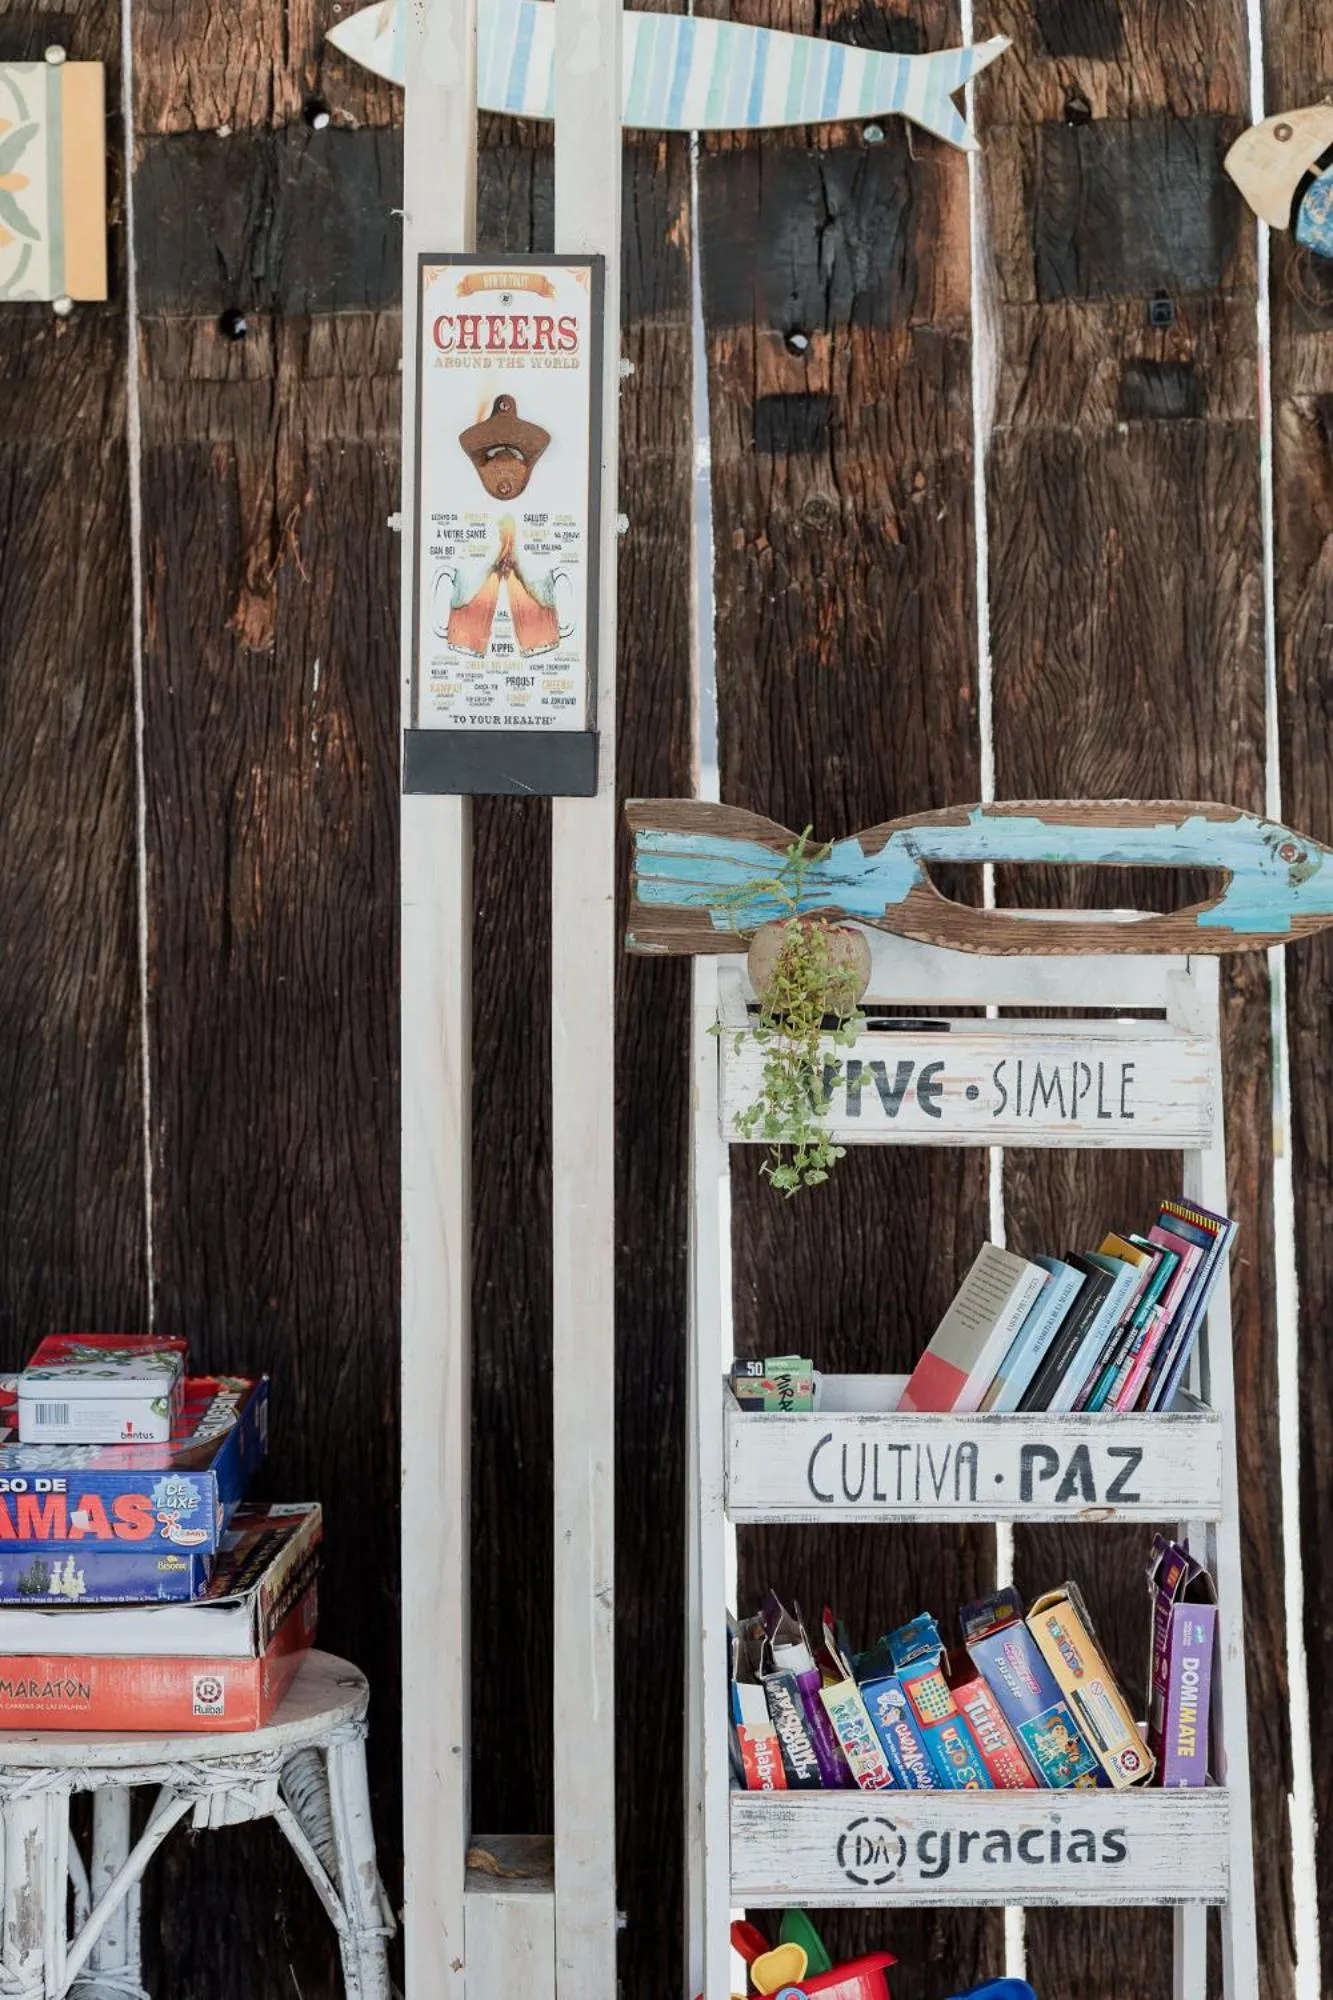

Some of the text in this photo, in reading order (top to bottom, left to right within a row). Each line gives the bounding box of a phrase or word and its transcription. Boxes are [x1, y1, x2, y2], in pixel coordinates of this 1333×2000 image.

[433, 315, 579, 352] CHEERS
[434, 357, 580, 369] AROUND THE WORLD
[470, 715, 501, 725] YOUR
[993, 1060, 1135, 1120] SIMPLE
[746, 1362, 763, 1376] 50
[808, 1433, 1143, 1504] CULTIVA PAZ
[35, 1478, 67, 1492] DE
[166, 1484, 186, 1496] DE
[156, 1496, 199, 1509] LUXE
[193, 1704, 223, 1714] Ruibal
[1177, 1657, 1200, 1757] DOMIMATE
[963, 1689, 1008, 1753] Tutti
[855, 1813, 1128, 1879] DA gracias
